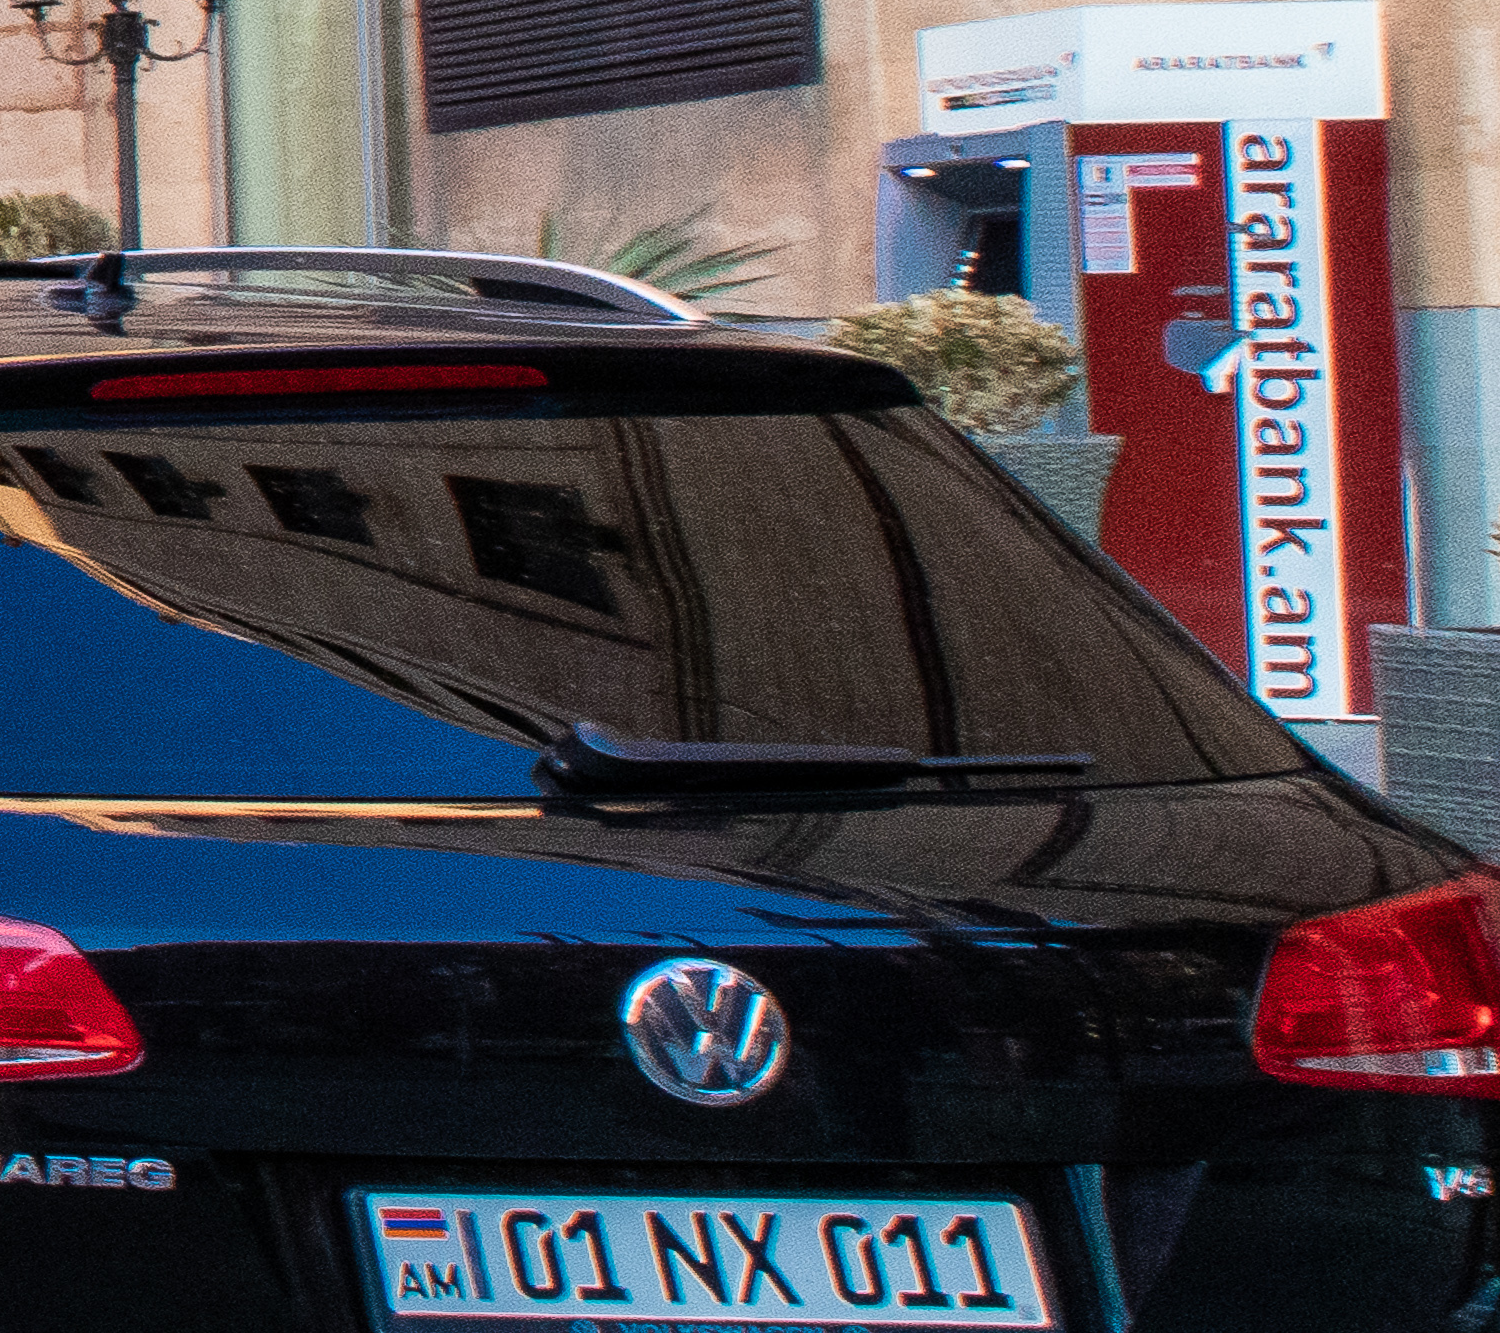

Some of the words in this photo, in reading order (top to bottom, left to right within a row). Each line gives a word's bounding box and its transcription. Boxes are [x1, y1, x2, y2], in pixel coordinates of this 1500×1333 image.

[1132, 53, 1306, 71] ARARATBANK
[1236, 132, 1327, 700] araratbank.am
[397, 1260, 464, 1300] AM
[499, 1208, 630, 1303] 01
[643, 1209, 803, 1306] NX
[818, 1212, 1016, 1309] 011
